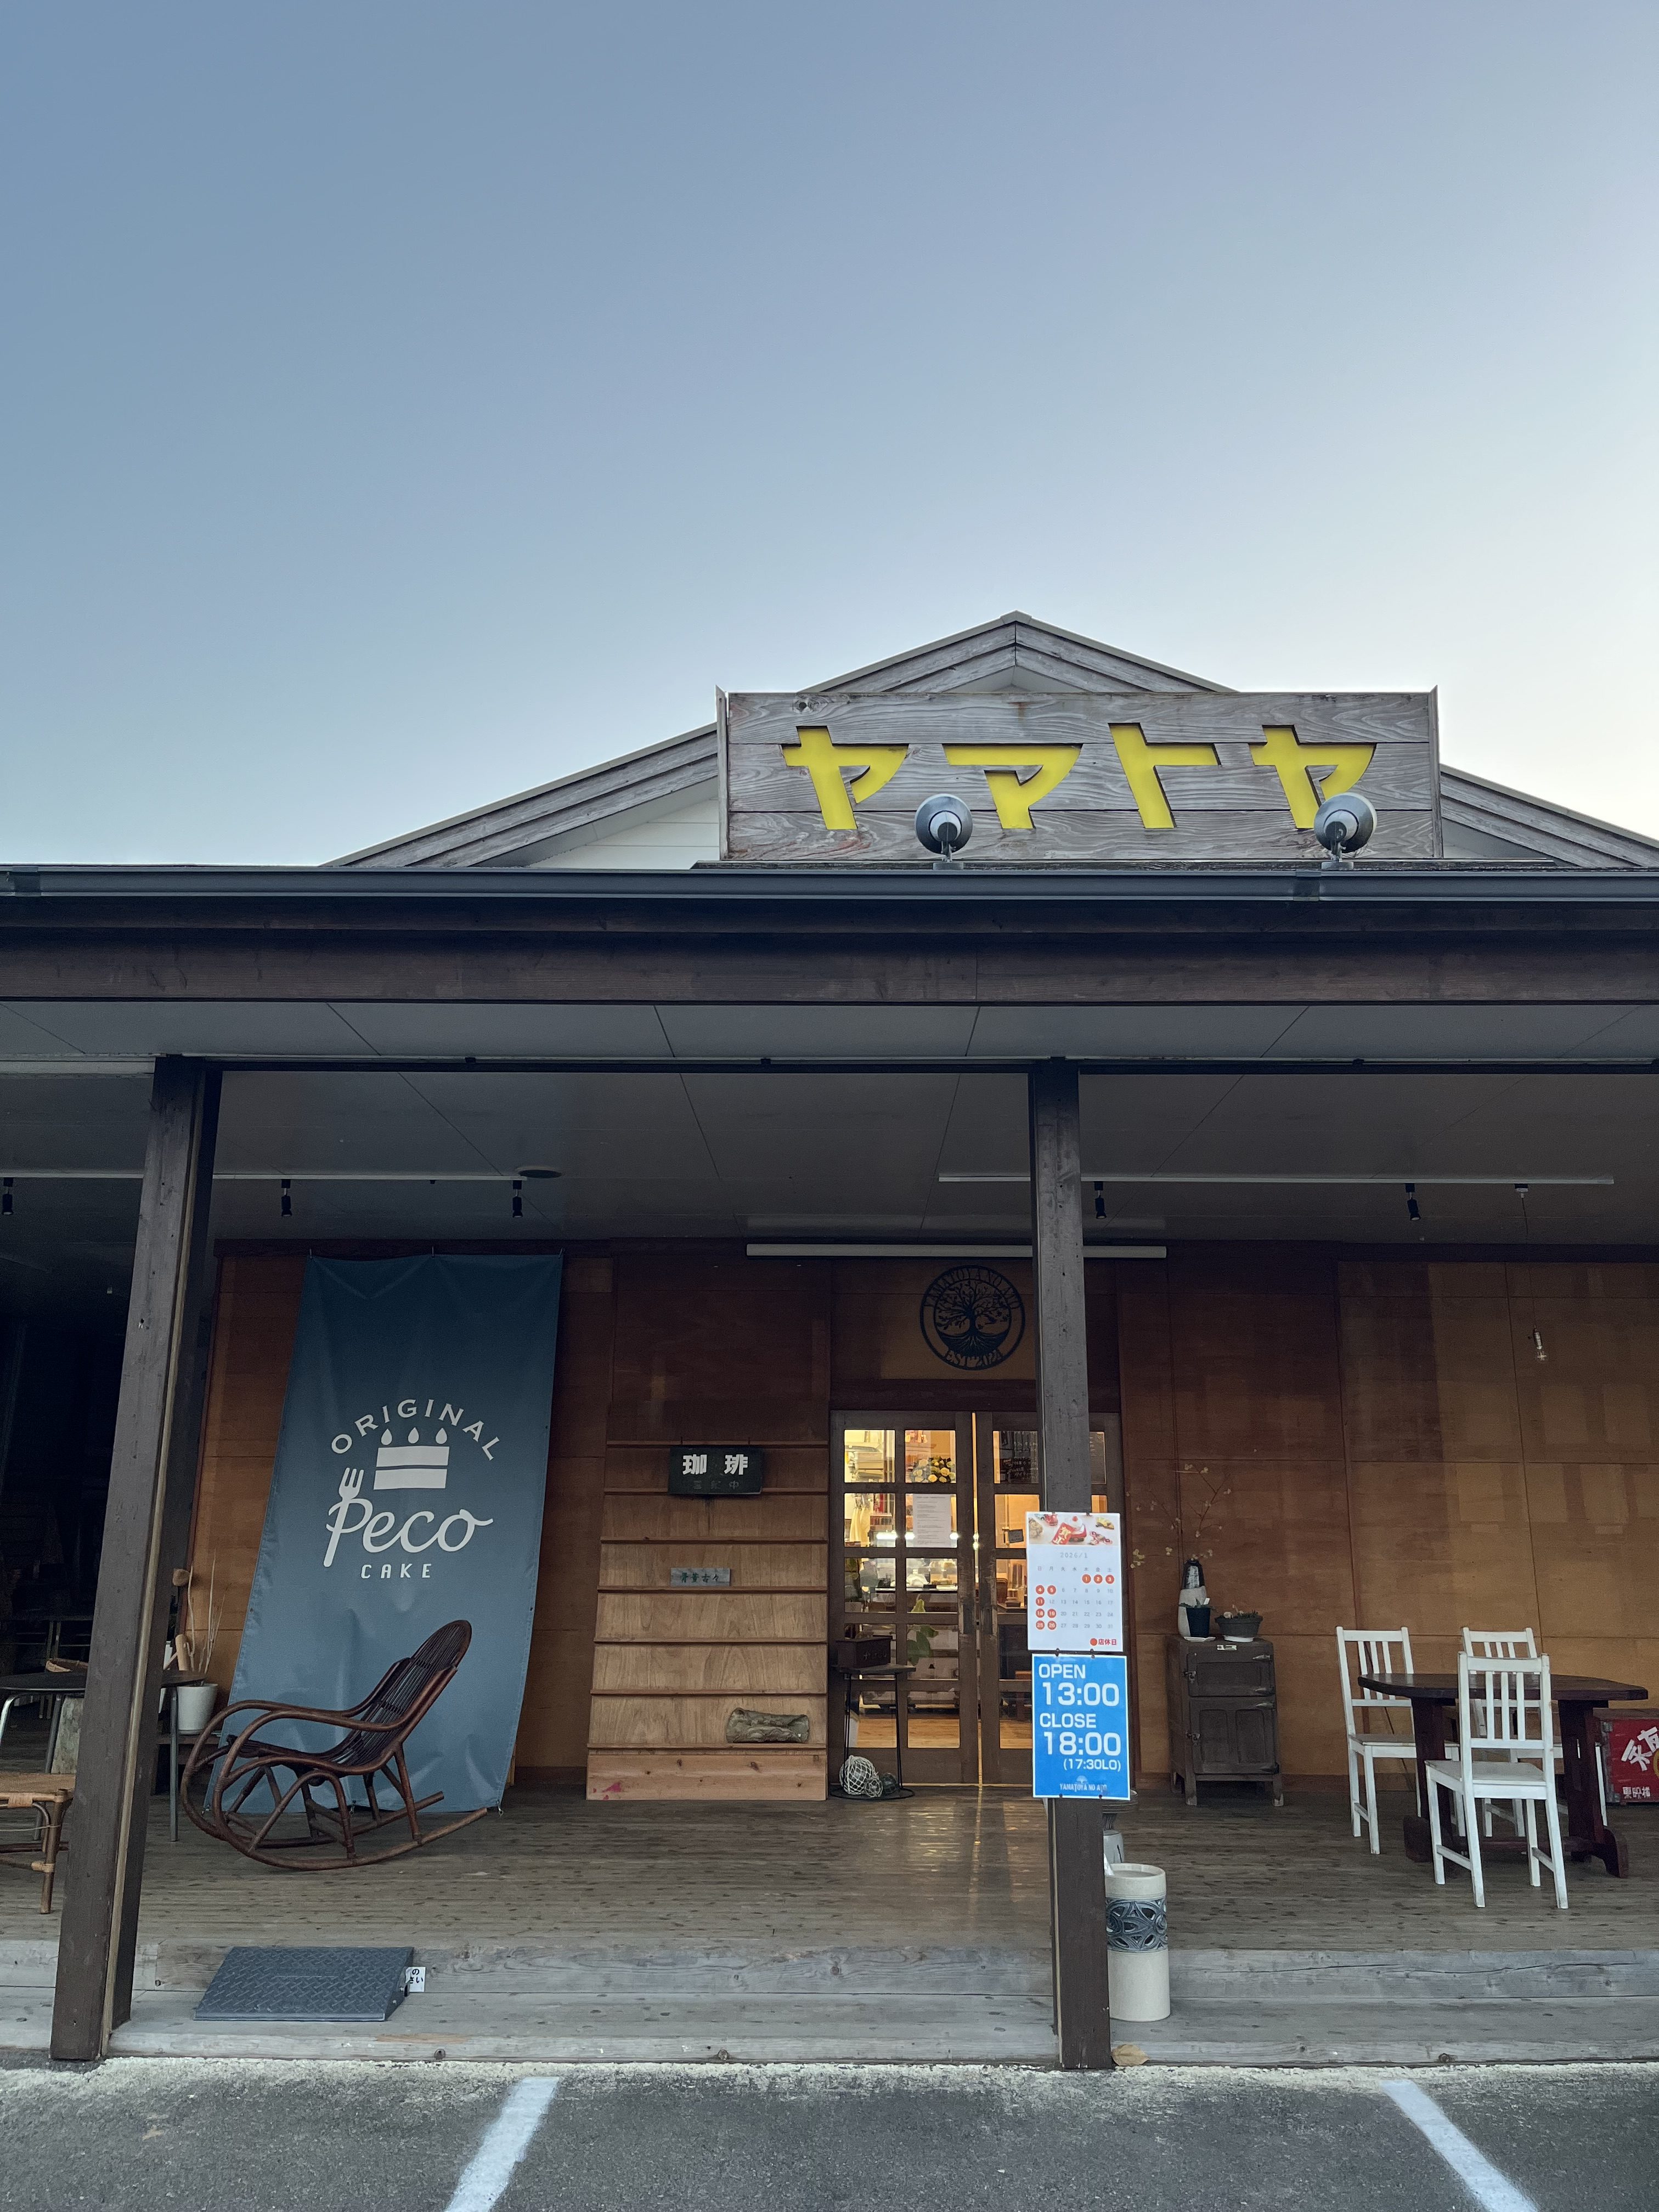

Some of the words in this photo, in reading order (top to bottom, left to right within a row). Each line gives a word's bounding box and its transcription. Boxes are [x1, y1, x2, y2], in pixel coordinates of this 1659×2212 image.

[781, 723, 1376, 829] ヤマトヤ
[331, 1398, 500, 1461] ORIGINAL
[682, 1454, 748, 1475] 珈琲
[323, 1481, 494, 1567] Peco
[360, 1562, 432, 1579] CAKE
[1039, 1663, 1086, 1679] OPEN
[1042, 1682, 1120, 1707] 13:00
[1040, 1712, 1096, 1729] CLOSE
[1043, 1731, 1121, 1756] 18:00
[1064, 1758, 1121, 1771] (17:30LO)
